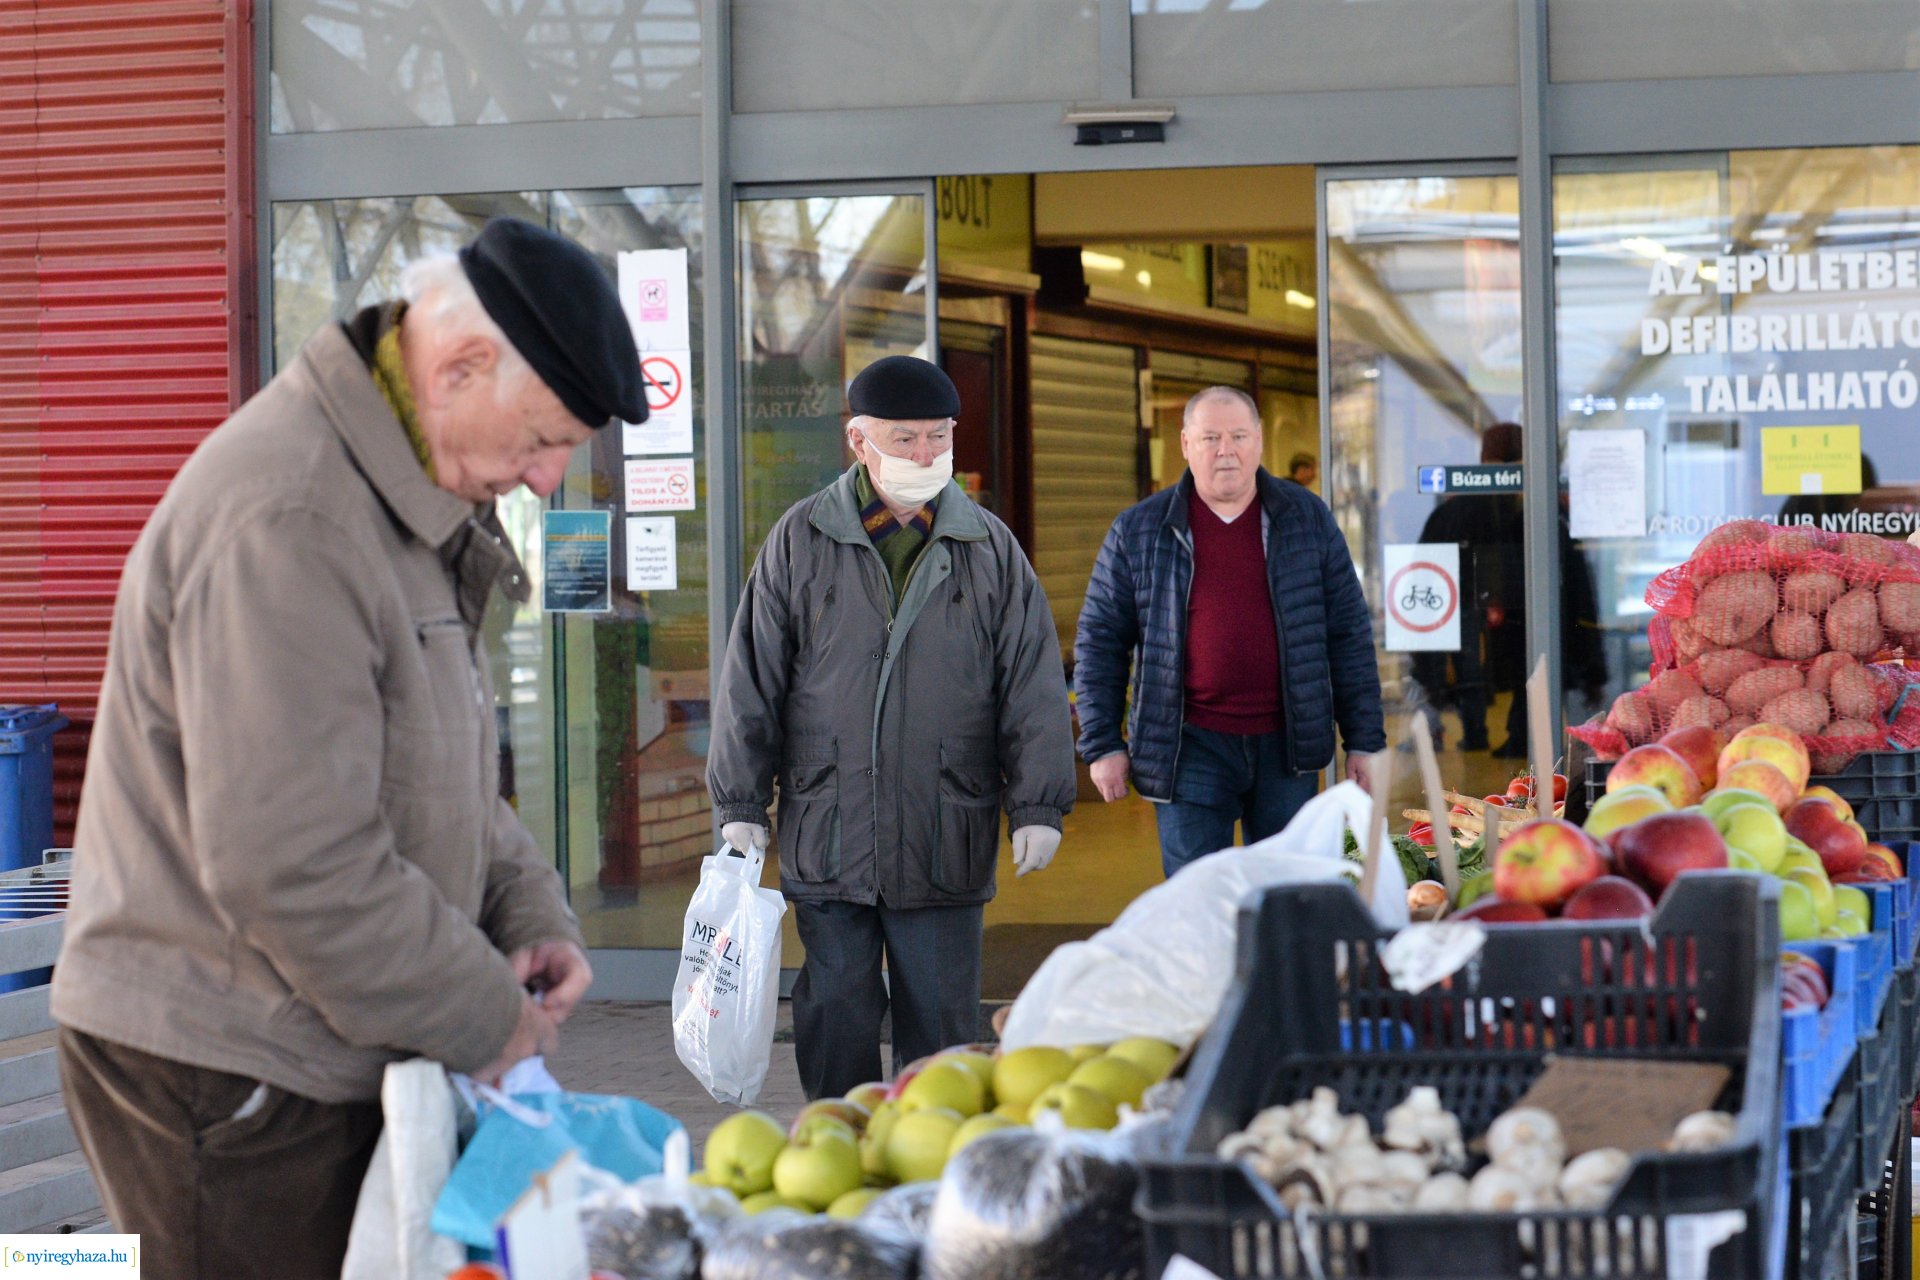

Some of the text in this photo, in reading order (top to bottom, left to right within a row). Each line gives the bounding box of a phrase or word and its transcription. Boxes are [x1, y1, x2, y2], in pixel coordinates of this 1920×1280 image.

[1649, 243, 1920, 296] AZ ÉPÜLETBE
[1640, 301, 1920, 356] DEFIBRILLÁTO
[1683, 358, 1919, 414] TALÁLHATÓ
[1452, 469, 1522, 487] Búza téri
[1671, 513, 1752, 535] ROTA
